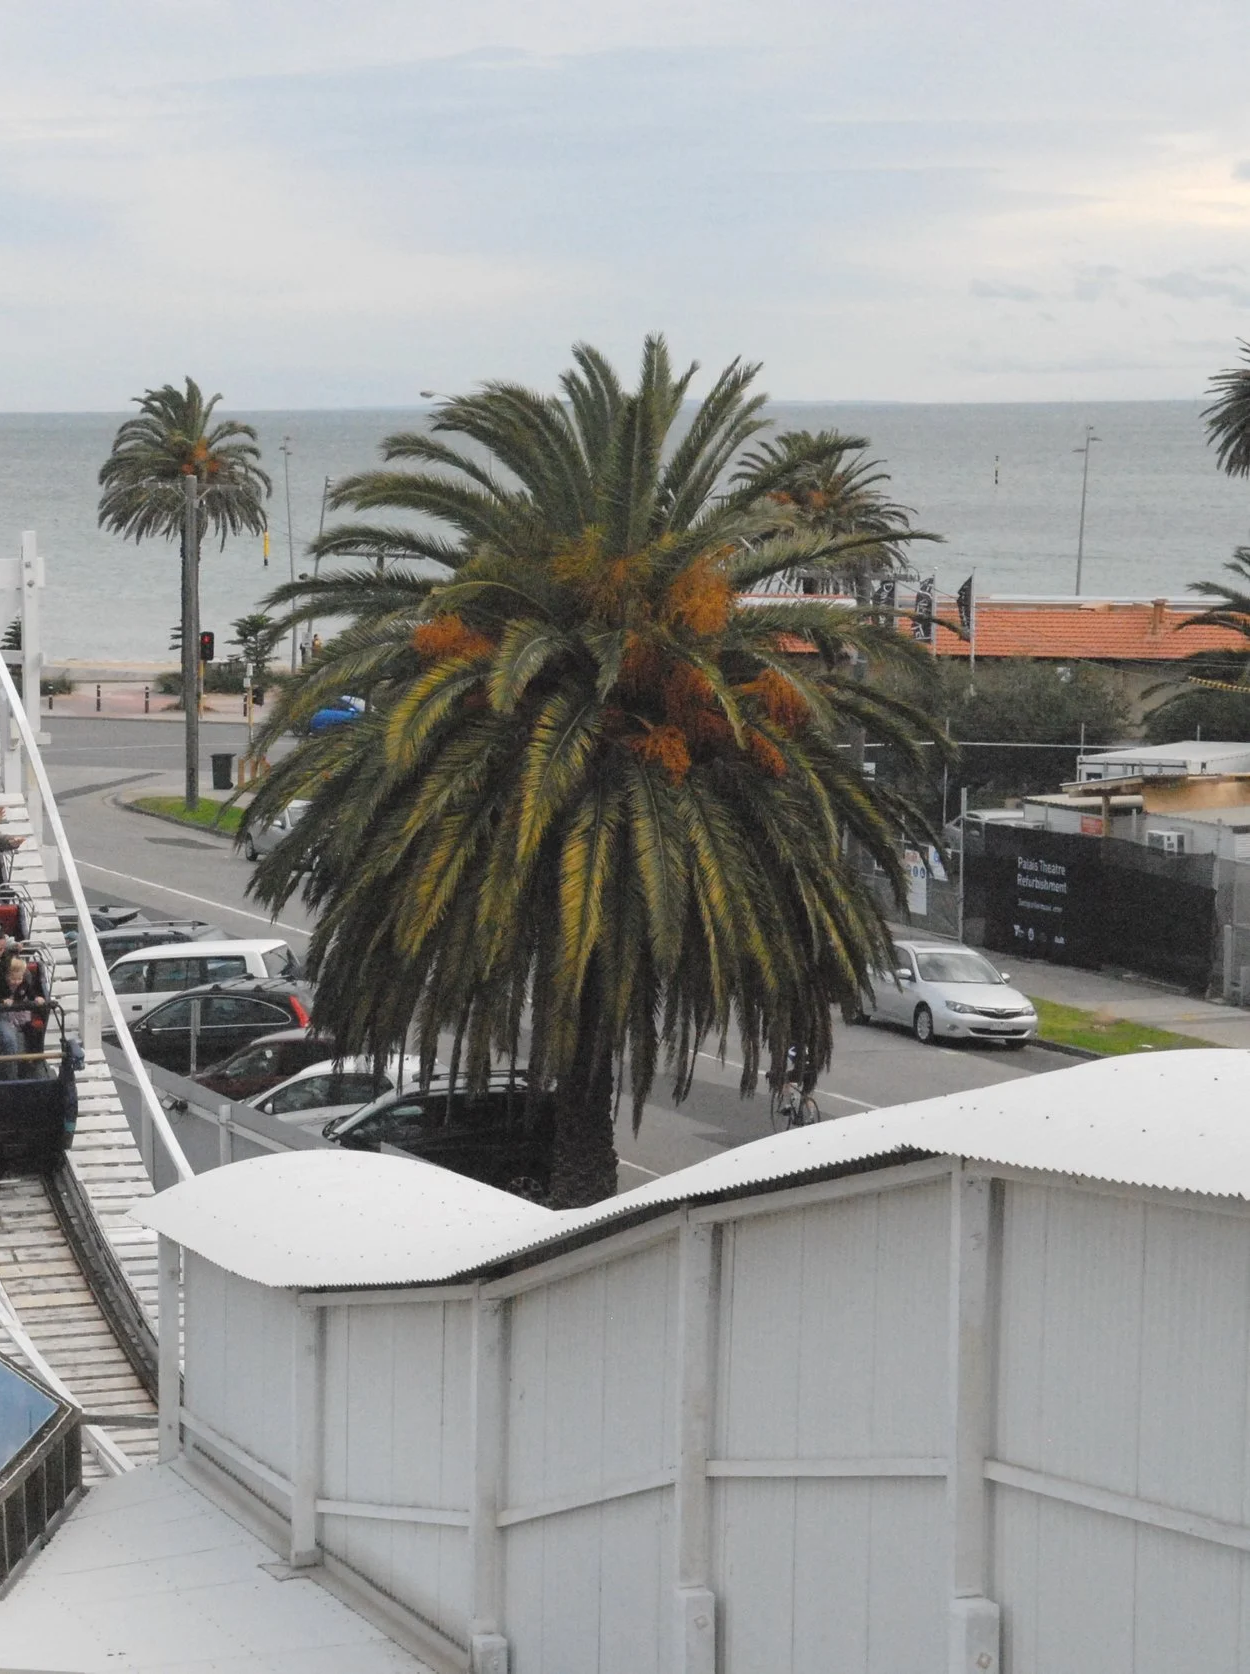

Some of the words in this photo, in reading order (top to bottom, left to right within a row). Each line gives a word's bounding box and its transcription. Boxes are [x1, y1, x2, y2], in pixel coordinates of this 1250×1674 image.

[1017, 856, 1039, 872] Palais
[1039, 859, 1066, 876] Theatre
[1017, 873, 1067, 894] Refurbishment
